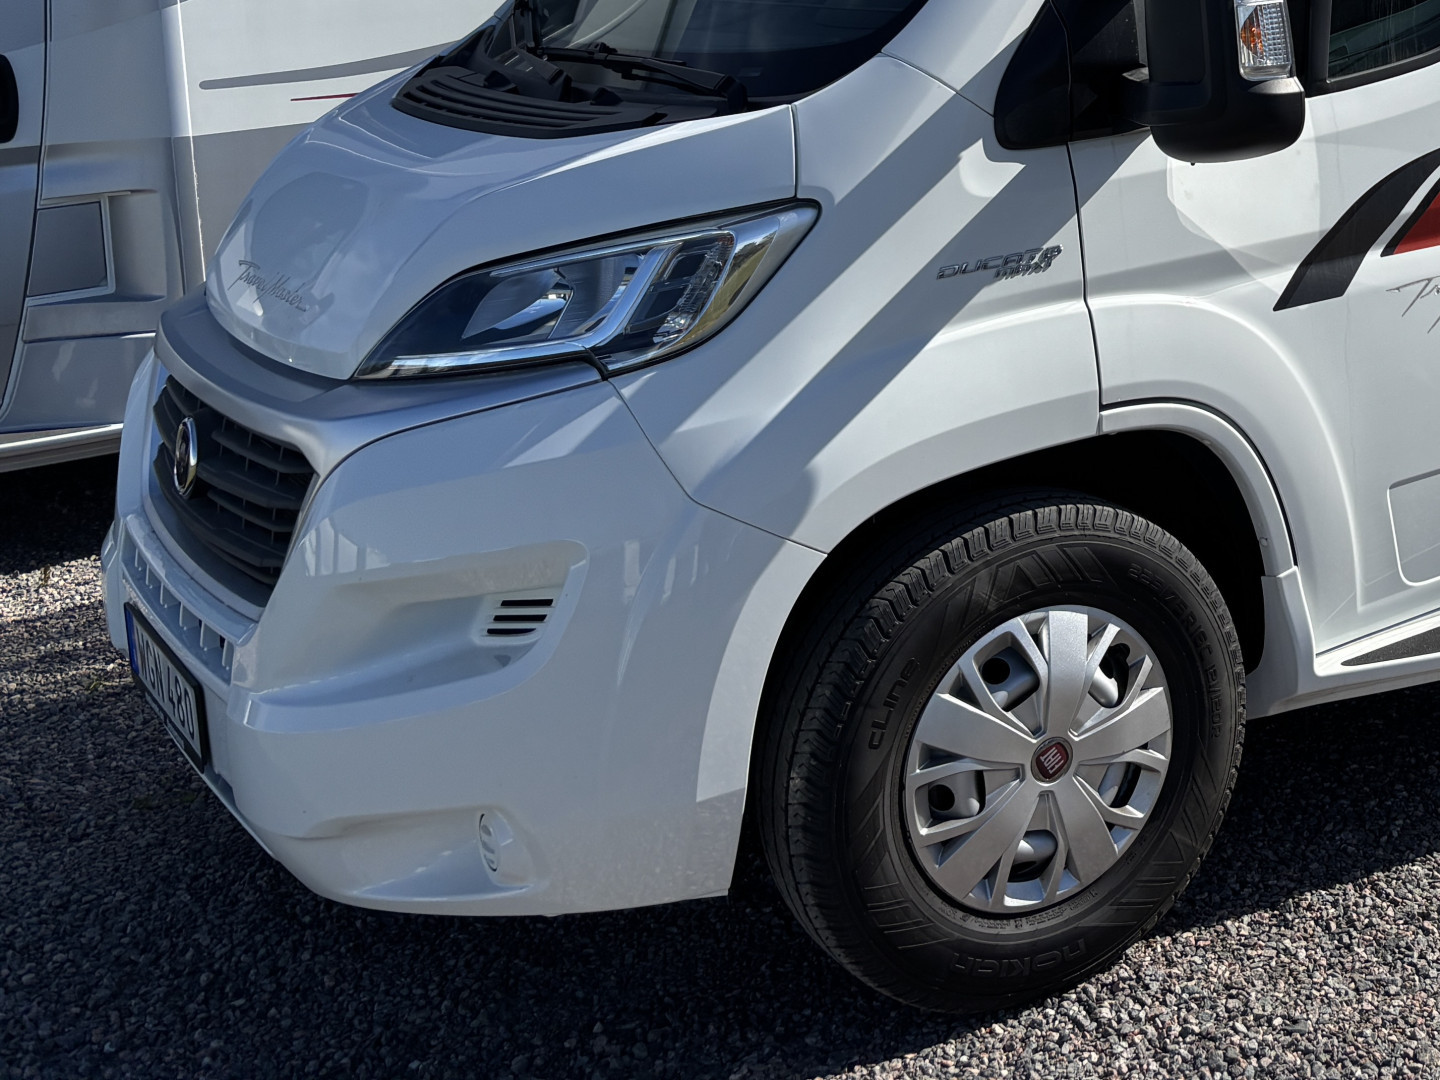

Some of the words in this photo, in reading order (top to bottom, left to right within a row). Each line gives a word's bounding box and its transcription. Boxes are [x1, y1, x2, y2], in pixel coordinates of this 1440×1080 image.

[936, 244, 1064, 280] DUCATO
[167, 665, 195, 740] 480
[1039, 746, 1065, 774] FIAT
